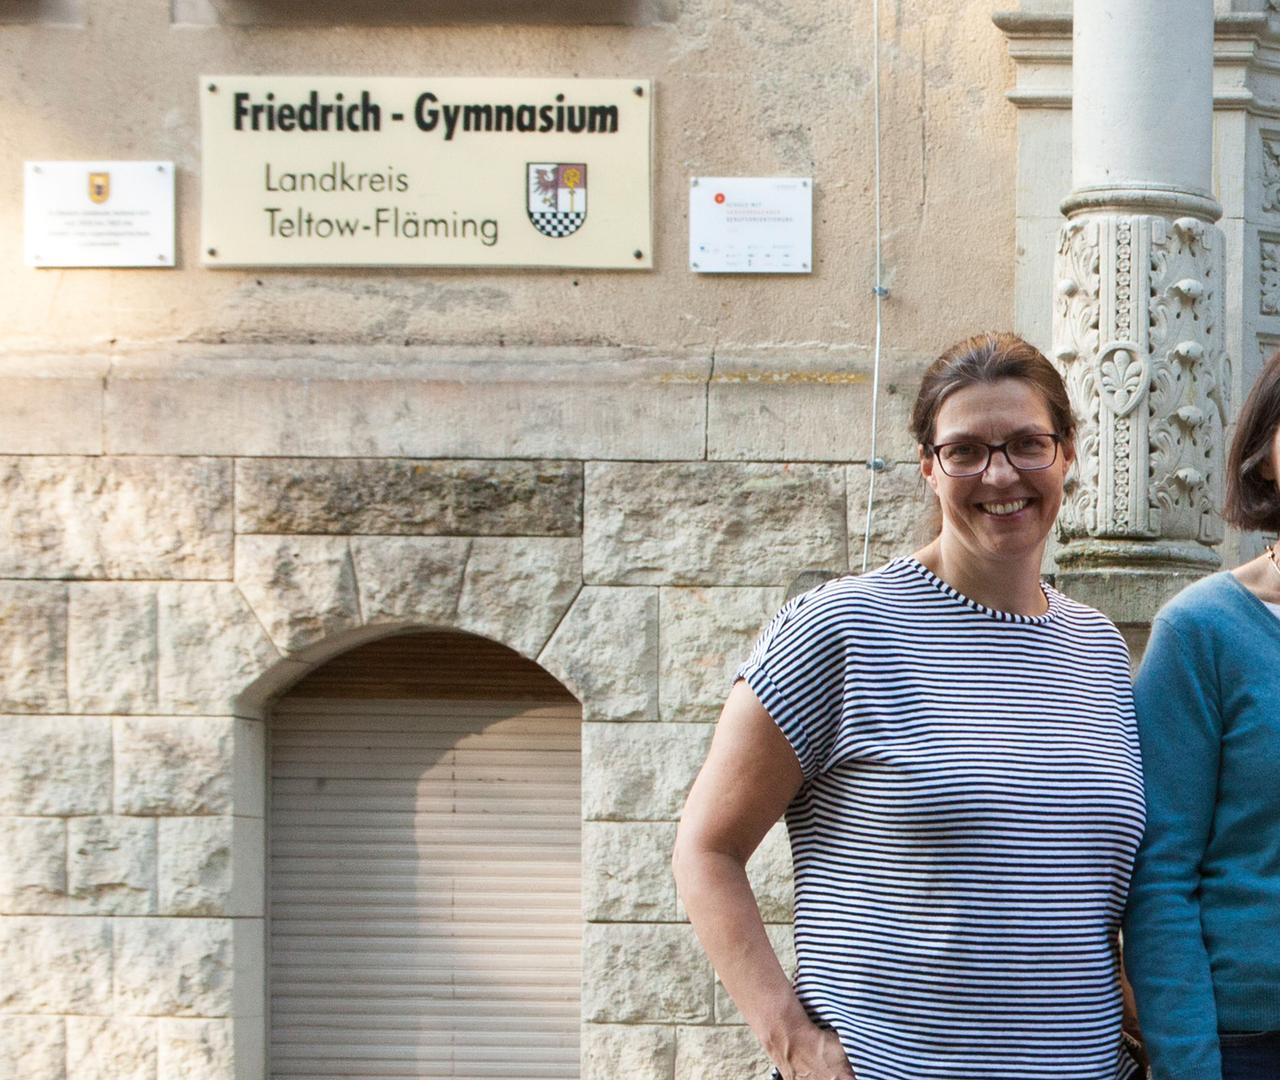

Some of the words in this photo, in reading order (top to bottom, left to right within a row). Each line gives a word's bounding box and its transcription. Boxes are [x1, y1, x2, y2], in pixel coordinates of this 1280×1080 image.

[234, 91, 381, 132] Friedrich
[414, 92, 619, 141] Gymnasium
[264, 161, 410, 192] Landkreis
[264, 206, 499, 246] Teltow-Fläming
